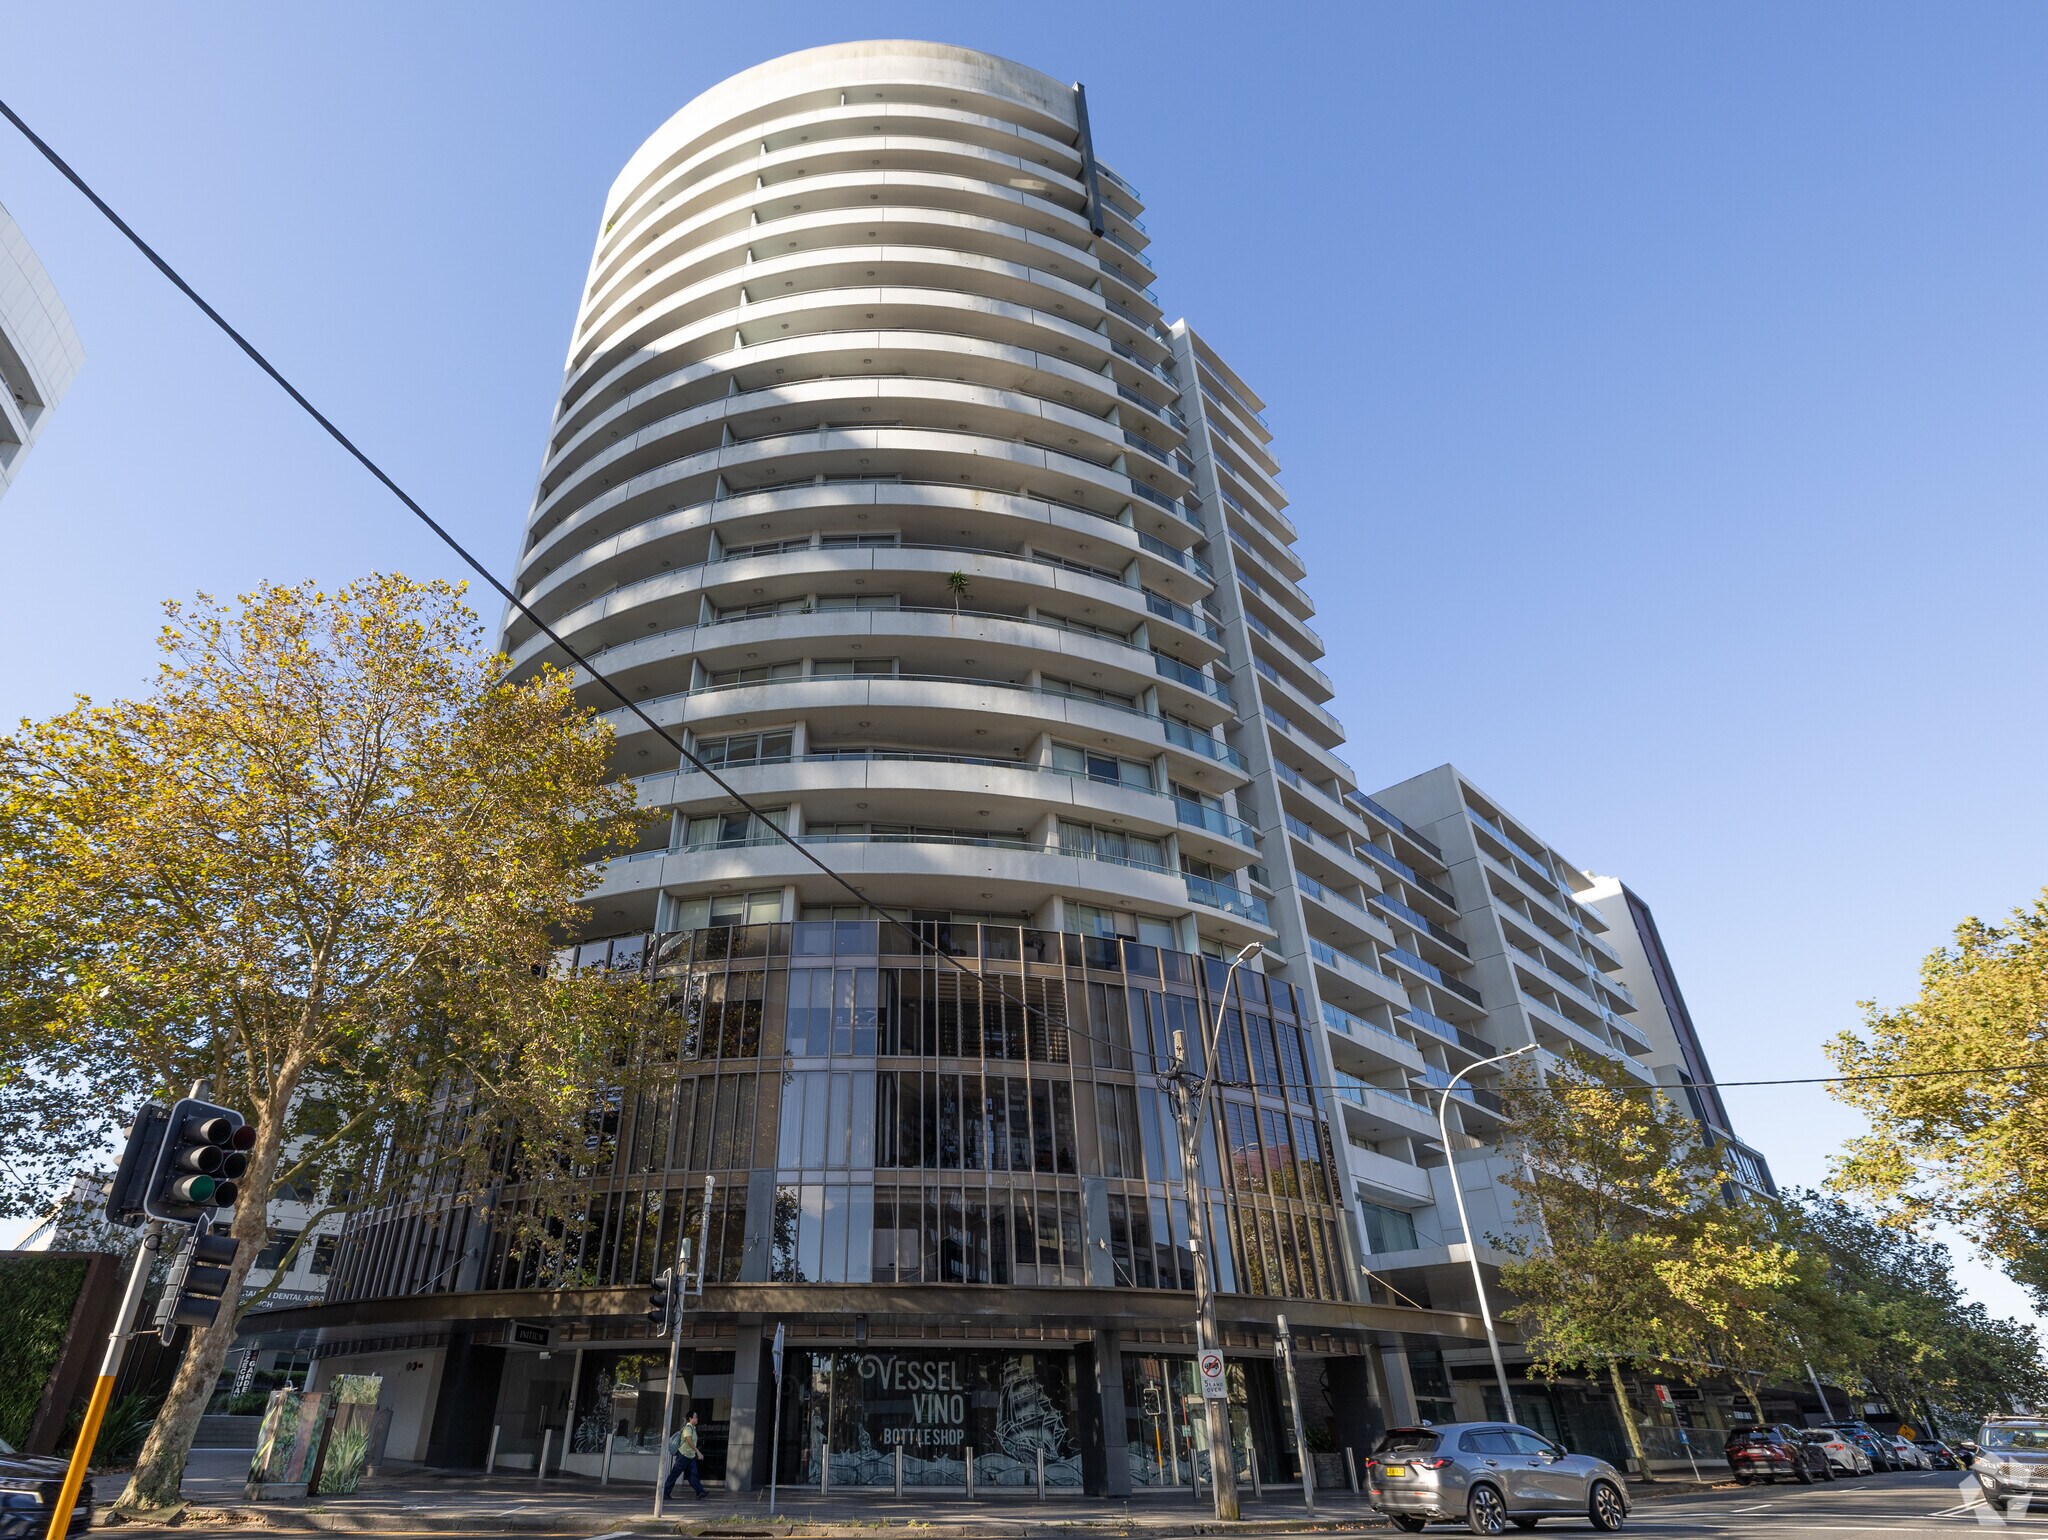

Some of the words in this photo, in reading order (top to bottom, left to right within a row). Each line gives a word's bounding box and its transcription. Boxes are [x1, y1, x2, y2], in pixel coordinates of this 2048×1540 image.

[273, 1292, 302, 1302] DENTAL
[240, 1360, 256, 1396] GARDE
[858, 1354, 964, 1391] VESSEL
[912, 1393, 964, 1424] VINO
